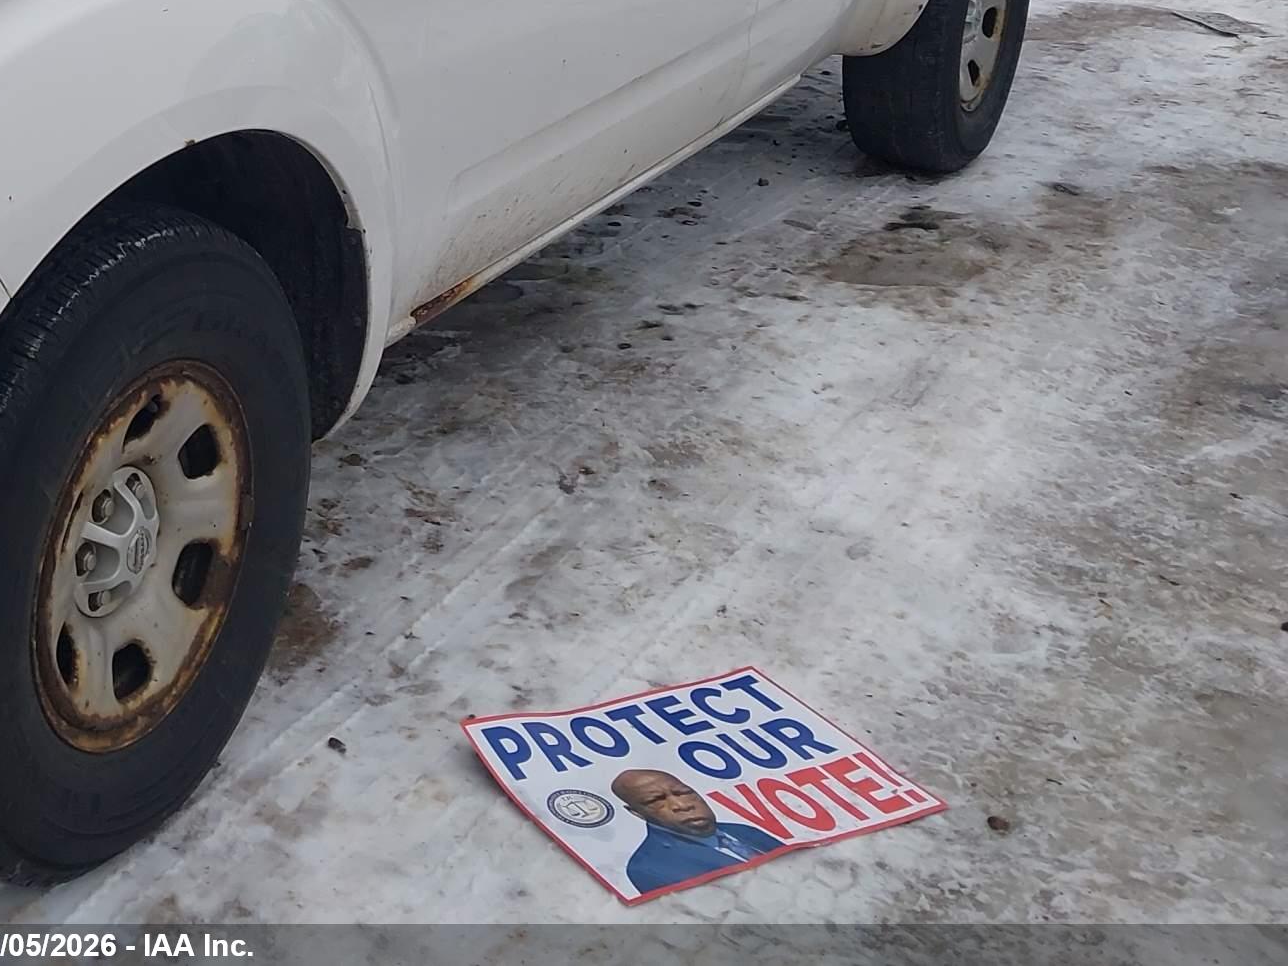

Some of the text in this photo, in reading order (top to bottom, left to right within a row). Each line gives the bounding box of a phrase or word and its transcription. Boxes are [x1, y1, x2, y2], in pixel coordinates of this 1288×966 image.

[481, 674, 785, 780] PROTECT
[677, 717, 838, 780] OUR
[708, 752, 926, 841] VOTE!
